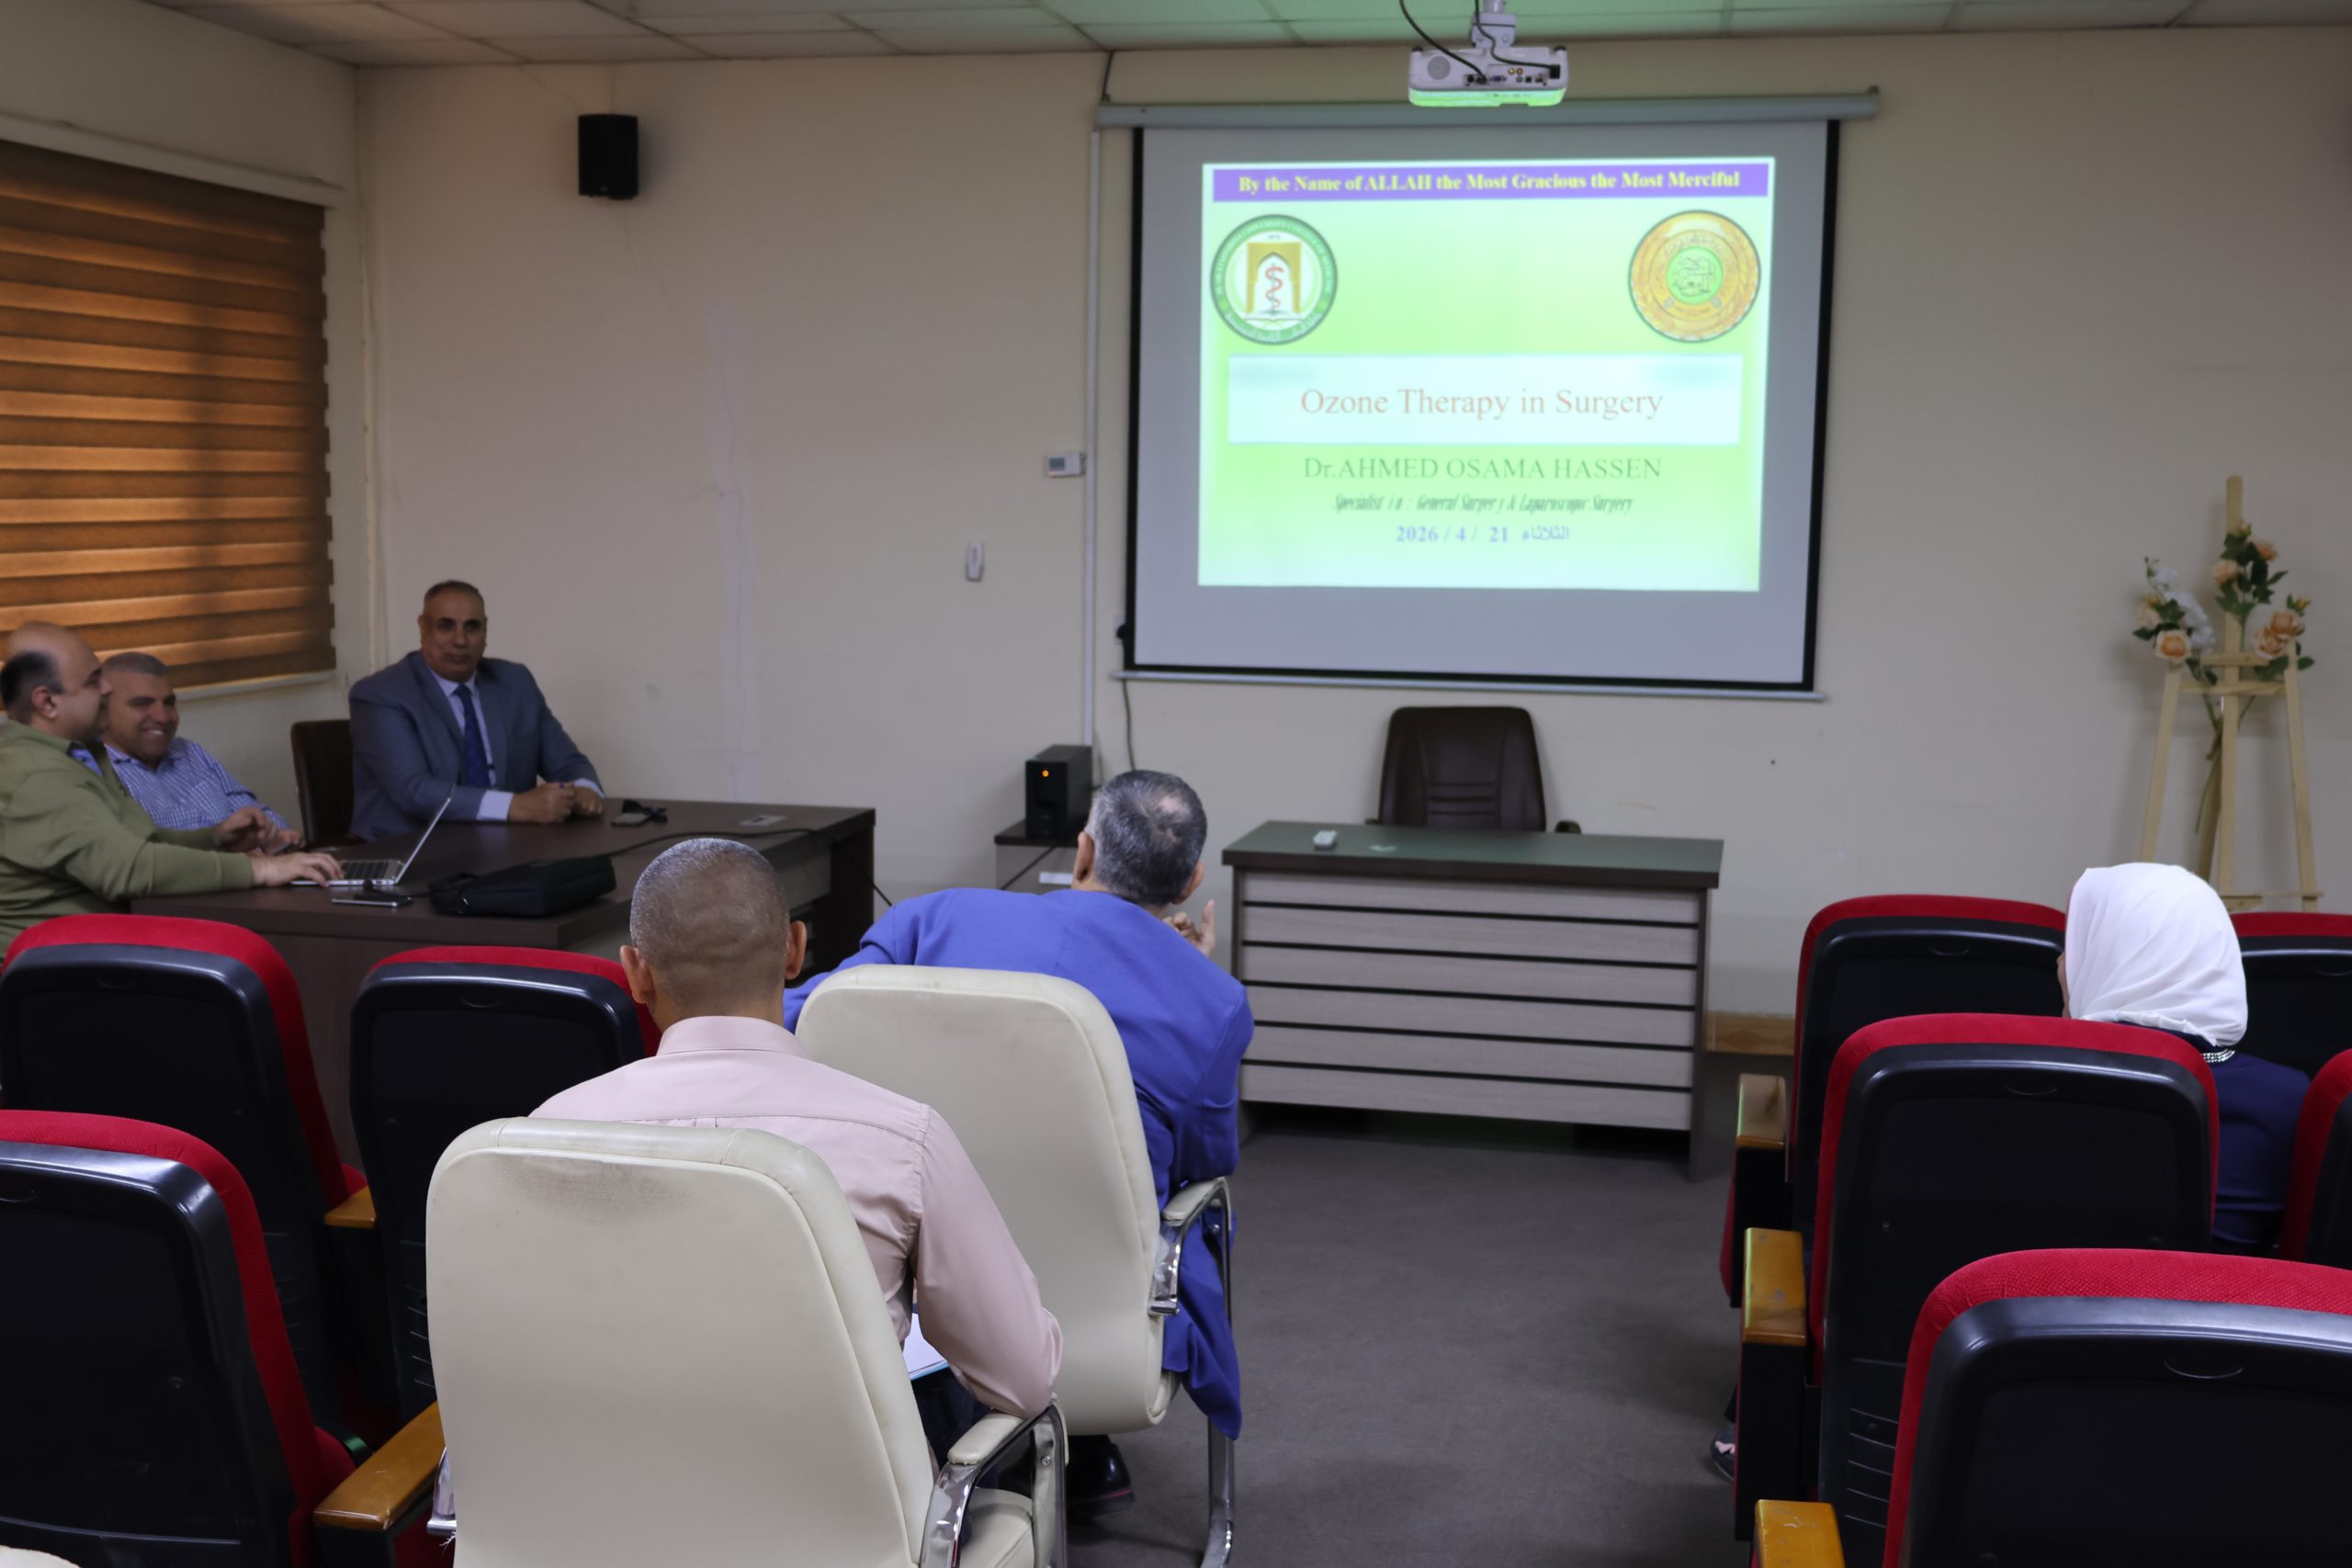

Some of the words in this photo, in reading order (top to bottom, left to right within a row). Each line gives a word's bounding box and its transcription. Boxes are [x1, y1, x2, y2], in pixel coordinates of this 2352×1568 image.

[1239, 177, 1260, 195] By
[1265, 176, 1290, 191] the
[1295, 175, 1340, 191] Name
[1345, 175, 1363, 191] of
[1365, 175, 1432, 190] ALLAH
[1436, 175, 1462, 190] the
[1466, 174, 1507, 189] Most
[1511, 173, 1587, 189] Gracious
[1590, 173, 1617, 188] the
[1621, 172, 1663, 188] Most
[1668, 171, 1740, 187] Merciful
[1301, 389, 1388, 413] Ozone
[1396, 388, 1511, 421] Therapy
[1521, 388, 1545, 413] in
[1555, 389, 1663, 421] Surgery
[1446, 457, 1545, 479] OSAMA
[1555, 457, 1661, 479] HASSEN
[1335, 493, 1384, 514] Specialist
[1417, 493, 1460, 511] General
[1519, 493, 1589, 514] Laparoscopic
[1591, 494, 1633, 514] Surgery
[1396, 525, 1439, 542] 2026
[1455, 526, 1466, 542] 4
[1489, 526, 1508, 543] 21
